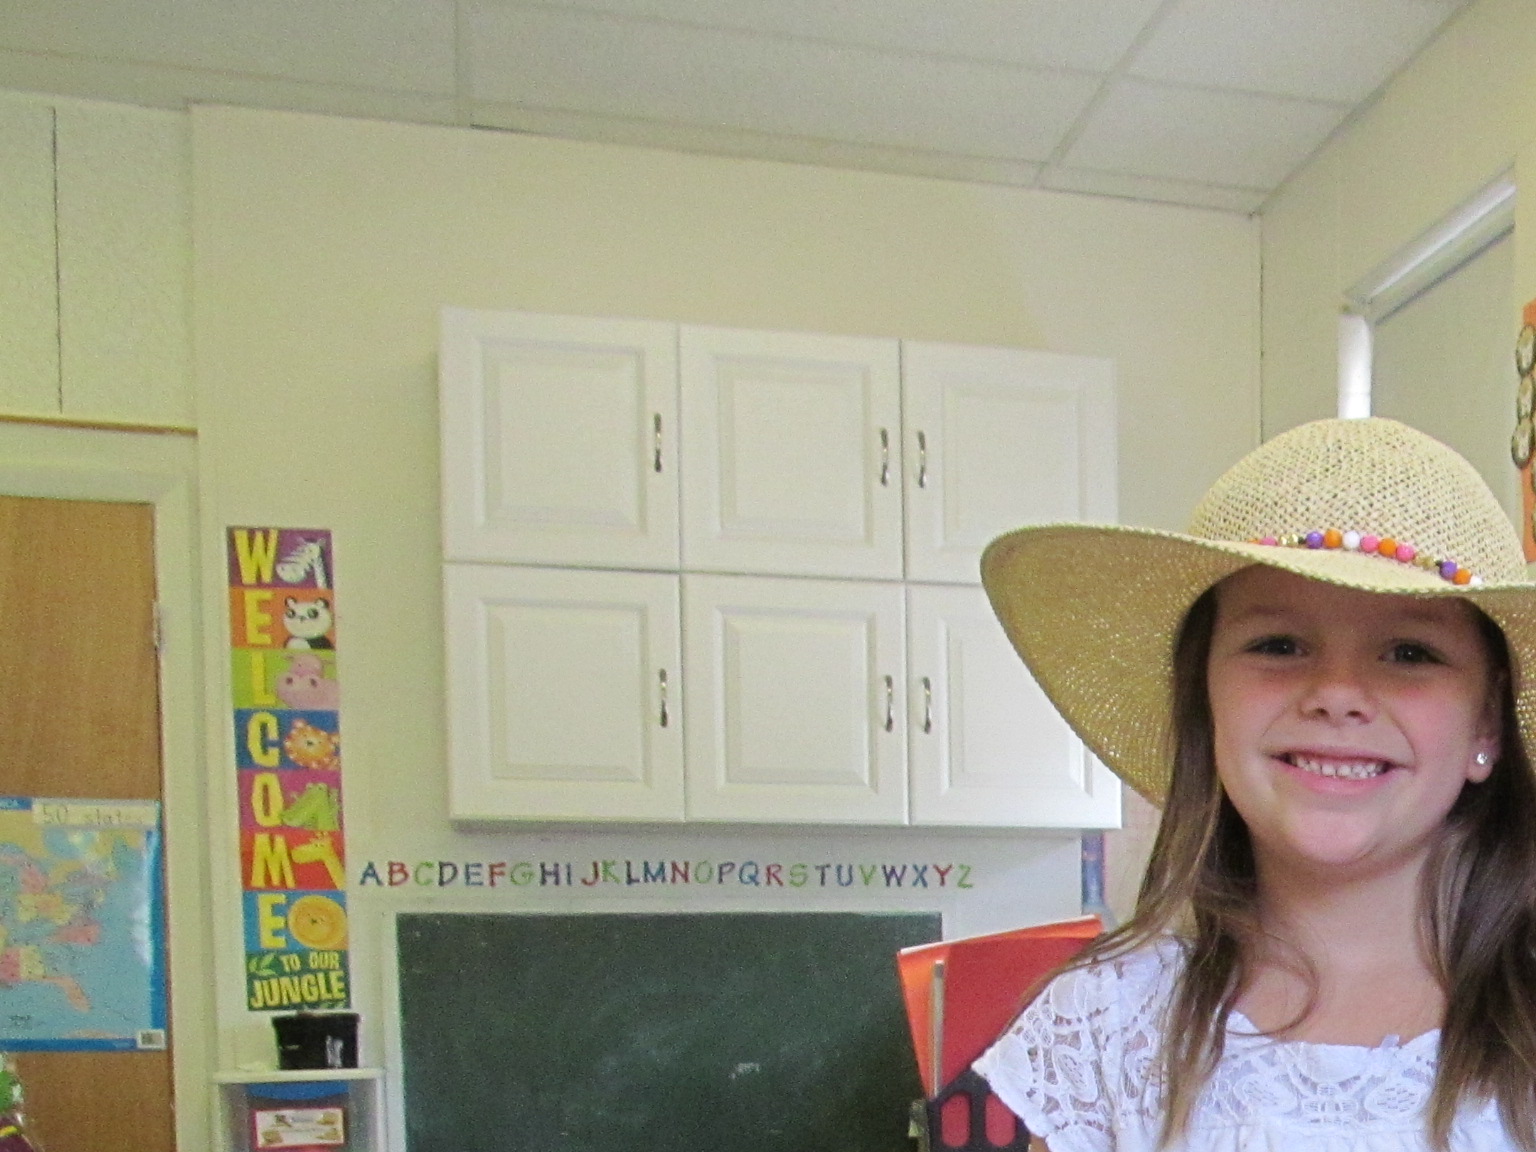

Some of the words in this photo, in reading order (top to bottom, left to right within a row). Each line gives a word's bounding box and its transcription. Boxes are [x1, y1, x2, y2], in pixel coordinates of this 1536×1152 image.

[233, 528, 296, 950] WELCOME
[280, 953, 301, 973] TO
[309, 951, 340, 969] OUR
[250, 970, 346, 1009] JUNGLE
